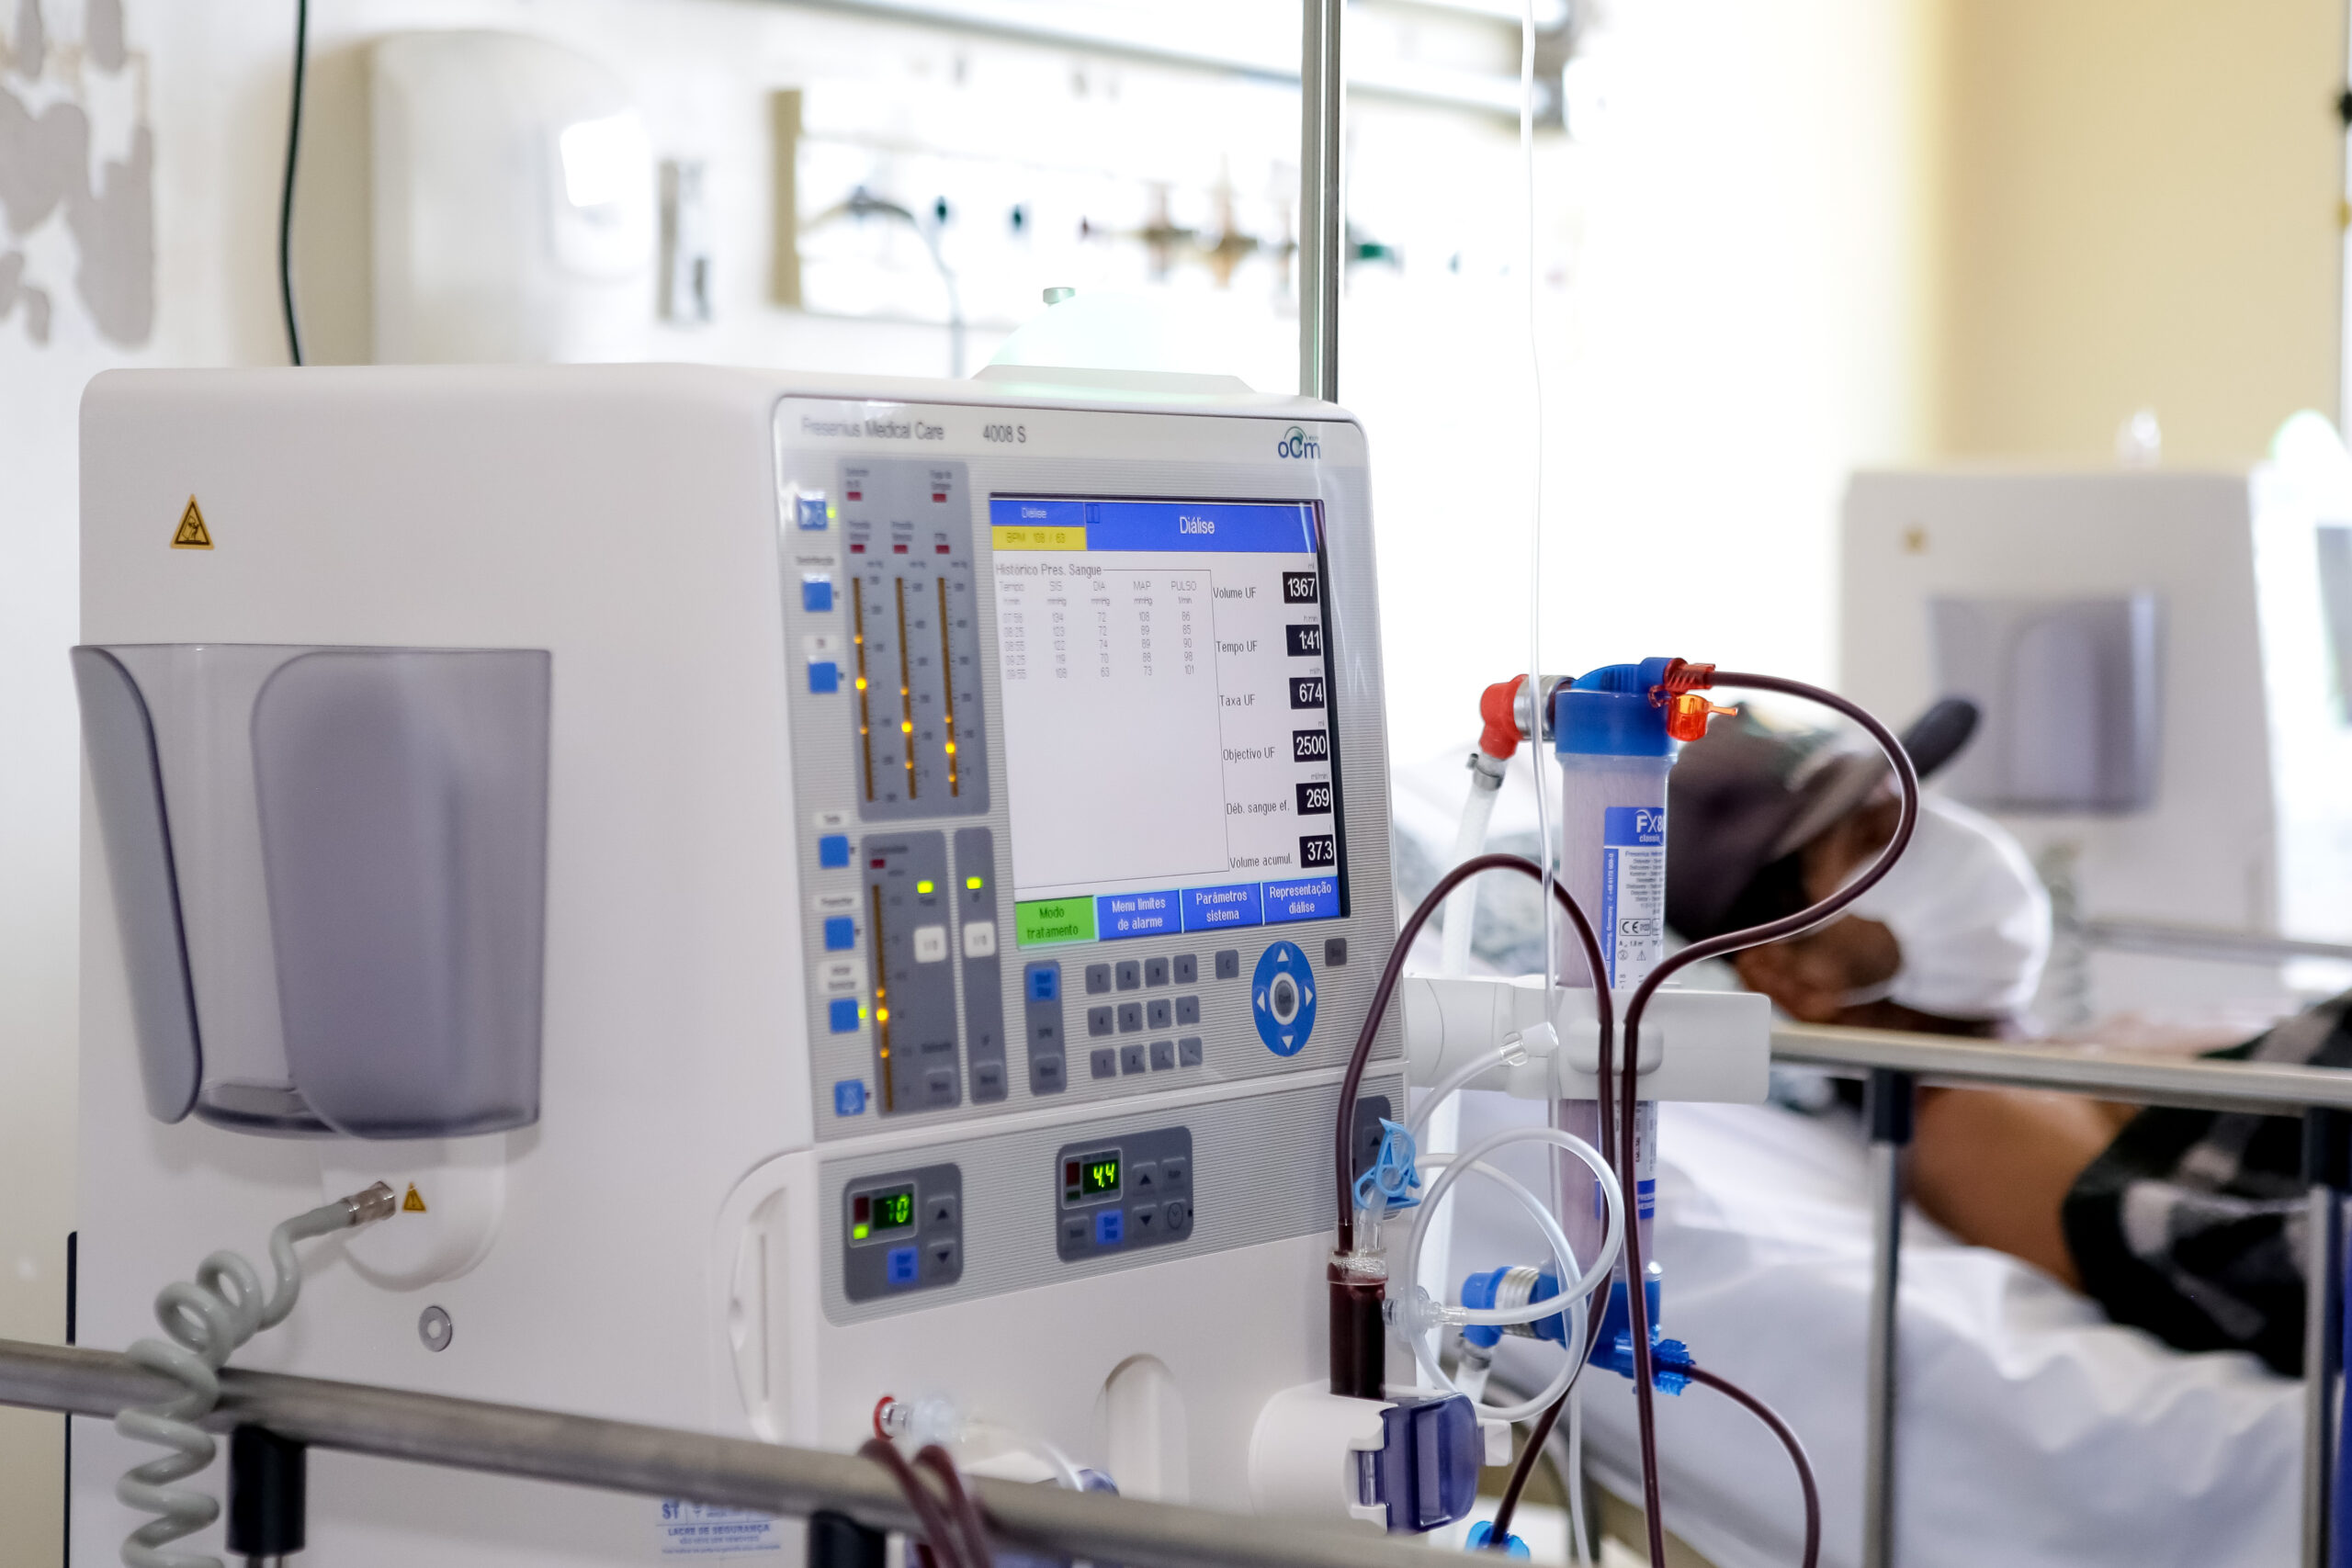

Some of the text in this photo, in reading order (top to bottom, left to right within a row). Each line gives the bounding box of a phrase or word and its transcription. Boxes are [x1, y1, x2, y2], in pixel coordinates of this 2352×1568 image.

[865, 420, 911, 439] Medical
[915, 422, 944, 441] Care
[983, 425, 1026, 444] 4008 S
[1180, 515, 1216, 535] Diálise
[996, 563, 1102, 579] Histórico Pres. Sangue
[1049, 581, 1063, 592] SIS
[1093, 581, 1105, 592] DIA
[1134, 581, 1151, 591] MAP
[1170, 581, 1197, 592] PULSO
[1213, 578, 1316, 599] Volume UF 1367
[1134, 597, 1153, 607] mmHg
[1098, 612, 1107, 623] 72
[1139, 612, 1150, 622] 108
[1182, 612, 1191, 622] 86
[1099, 626, 1108, 637] 72
[1141, 626, 1150, 636] 89
[1182, 625, 1192, 635] 85
[1141, 638, 1151, 649] 89
[1183, 638, 1193, 649] 90
[1216, 629, 1320, 654] Tempo UF 1:41
[1183, 651, 1193, 661] 98
[1144, 666, 1153, 676] 73
[1184, 665, 1194, 675] 101
[1219, 682, 1323, 706] Taxa UF 674
[1223, 735, 1326, 763] Objectivo UF 2500
[1227, 787, 1330, 817] Déb. sangue ef. 269
[1229, 840, 1333, 869] Volume acumul. 37.3
[1195, 890, 1248, 906] Parâmetros
[1269, 881, 1332, 901] Representação
[1039, 907, 1065, 919] Modo
[1112, 897, 1166, 913] Menu limites
[1289, 902, 1316, 915] diálise
[1206, 908, 1240, 922] sistema
[1117, 917, 1163, 931] de alarme
[1027, 925, 1079, 941] tratamento
